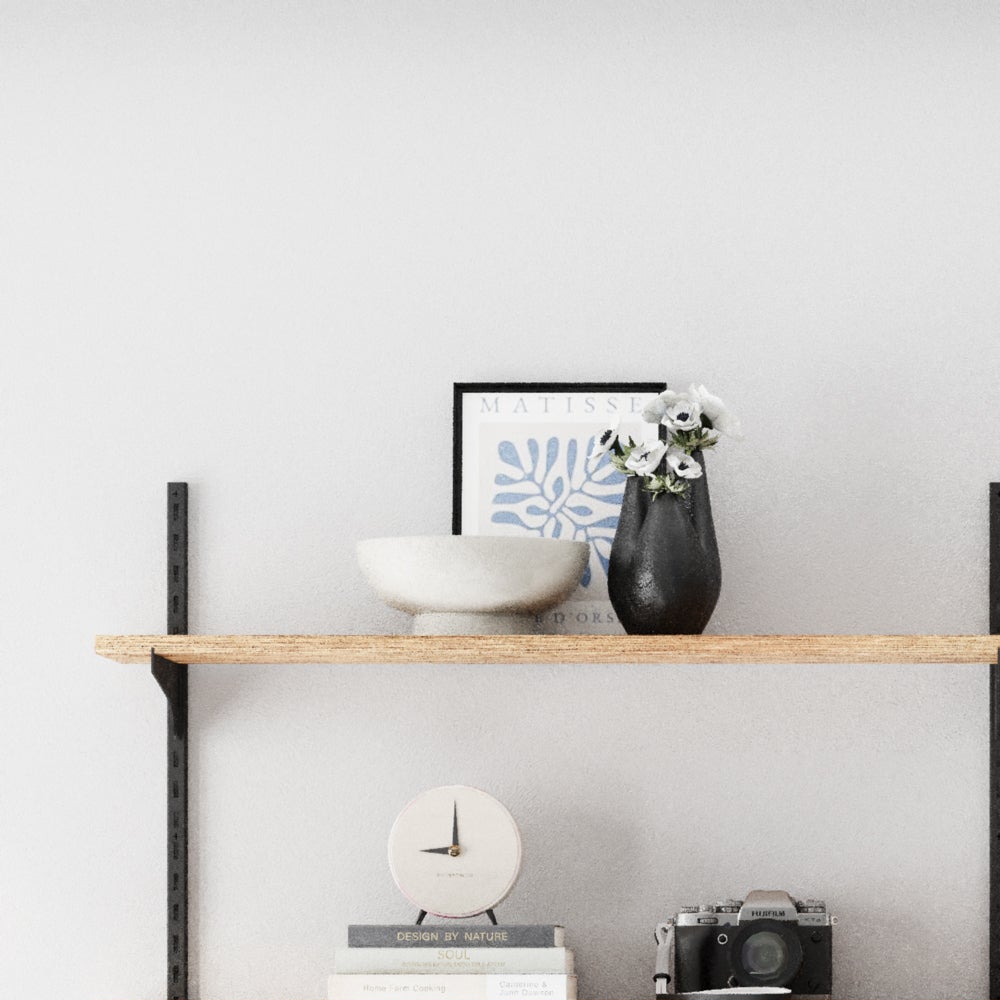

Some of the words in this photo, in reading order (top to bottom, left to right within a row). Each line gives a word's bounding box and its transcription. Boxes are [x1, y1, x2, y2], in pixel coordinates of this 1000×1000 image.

[480, 396, 643, 414] MATISSE
[397, 932, 438, 941] DESIGN
[445, 932, 458, 941] BY
[464, 932, 508, 941] NATURE
[438, 950, 470, 960] SOUL
